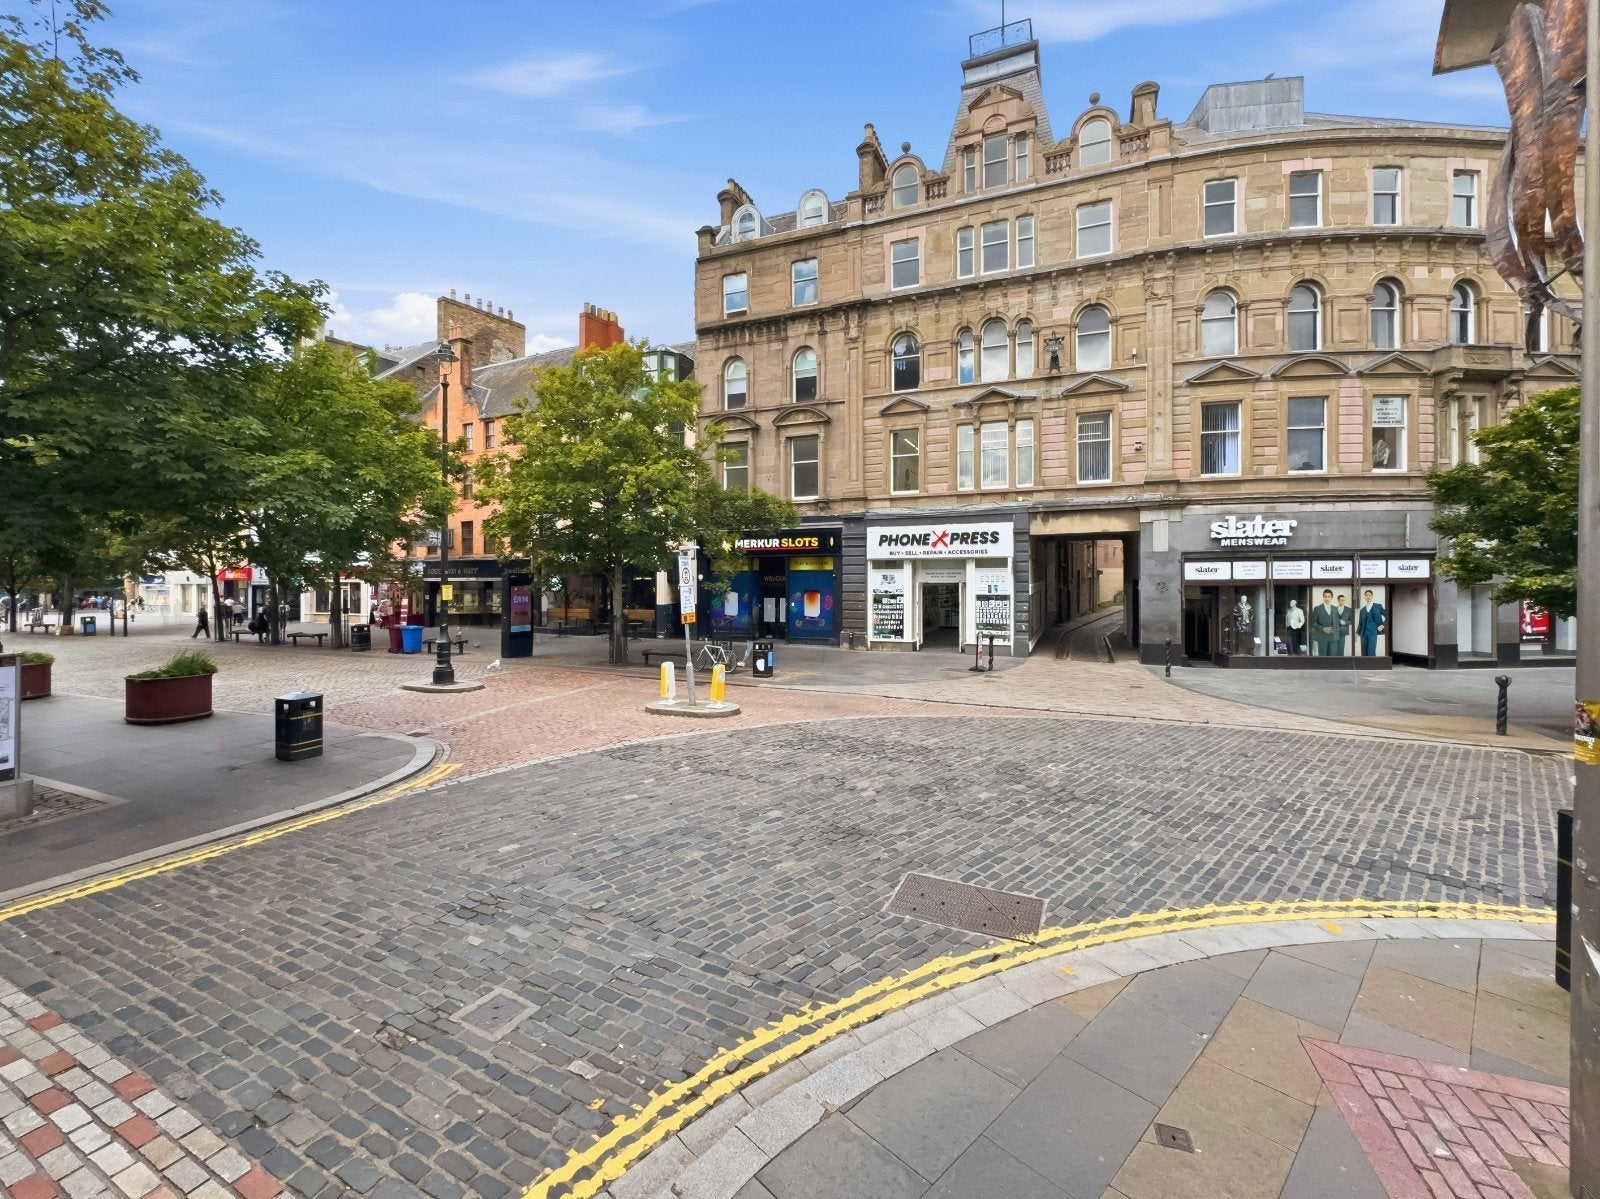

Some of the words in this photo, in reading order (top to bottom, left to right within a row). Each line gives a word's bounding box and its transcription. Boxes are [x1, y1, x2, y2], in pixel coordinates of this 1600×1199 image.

[1210, 515, 1298, 538] slater
[735, 538, 780, 549] MERKUR
[781, 537, 819, 548] SLOTS
[1220, 538, 1287, 547] MENSWEAR
[1320, 564, 1344, 572] slater
[1397, 563, 1419, 571] slater
